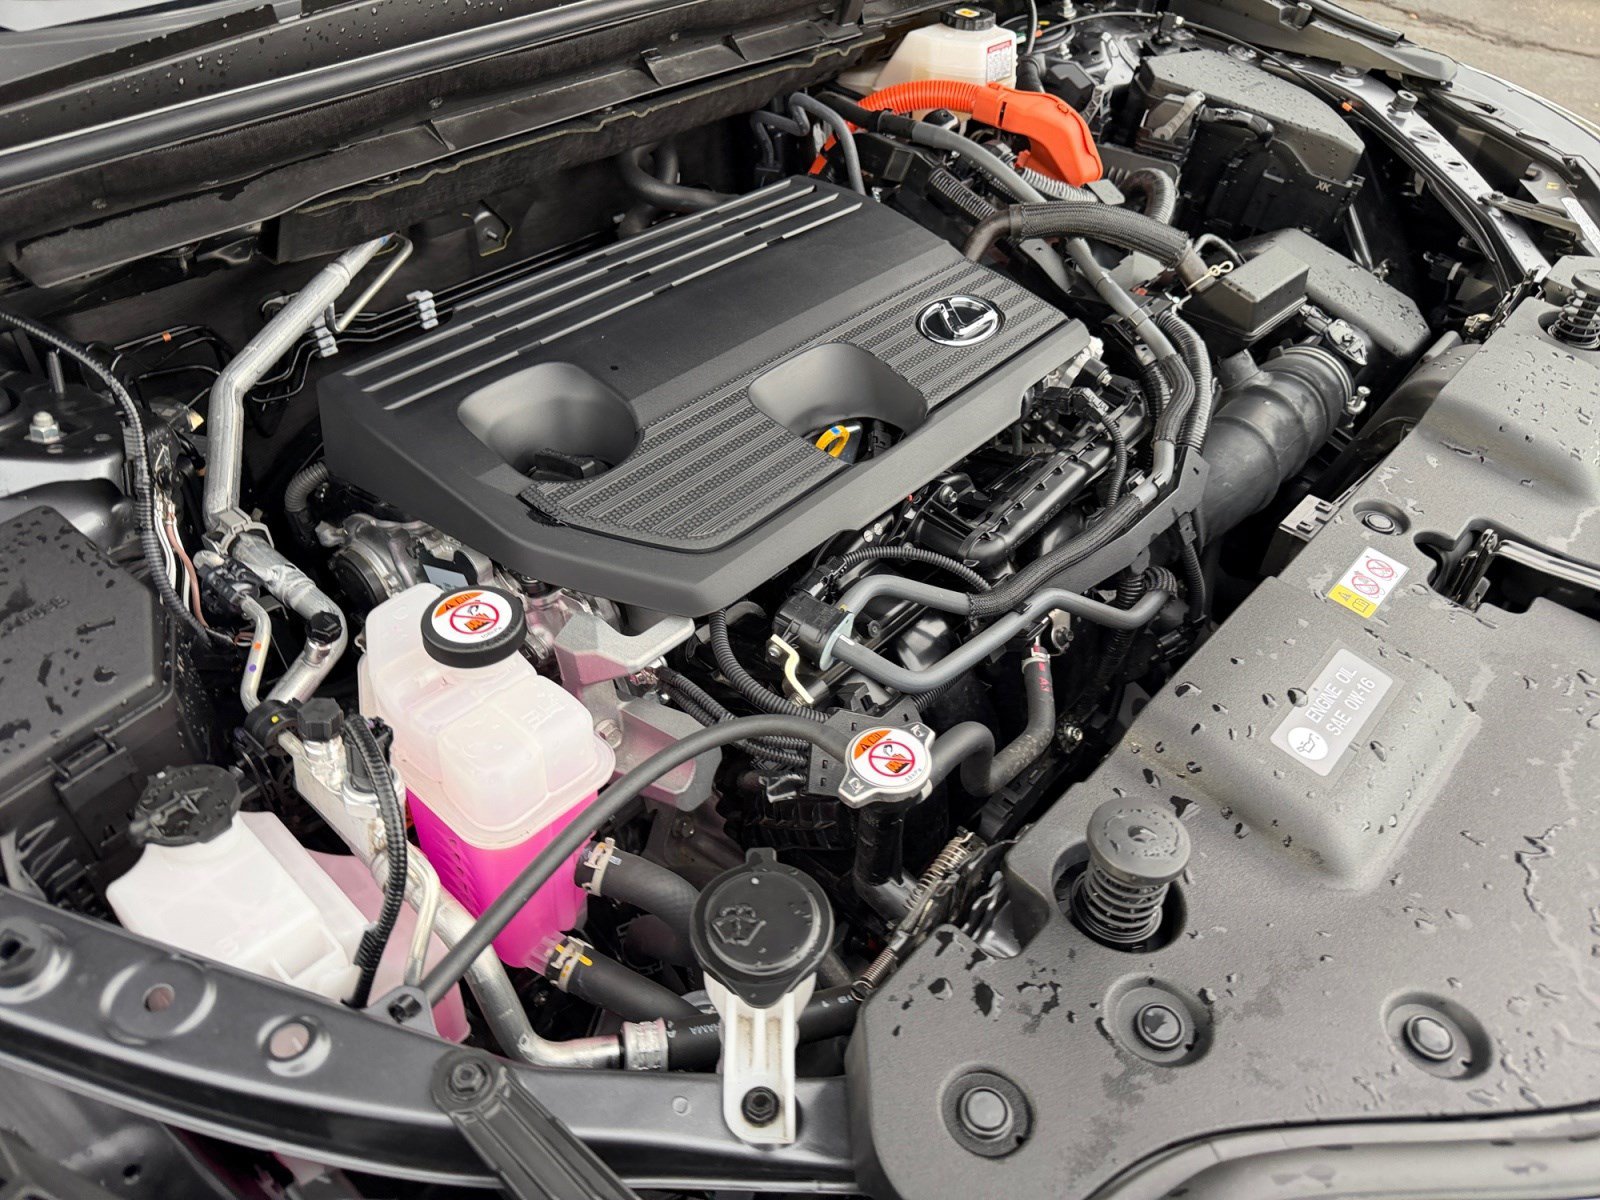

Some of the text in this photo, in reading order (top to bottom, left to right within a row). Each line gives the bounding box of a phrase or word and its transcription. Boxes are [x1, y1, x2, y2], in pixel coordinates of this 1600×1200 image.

[1305, 666, 1358, 724] ENGINE OIL
[1325, 677, 1376, 736] SAE 0W-16
